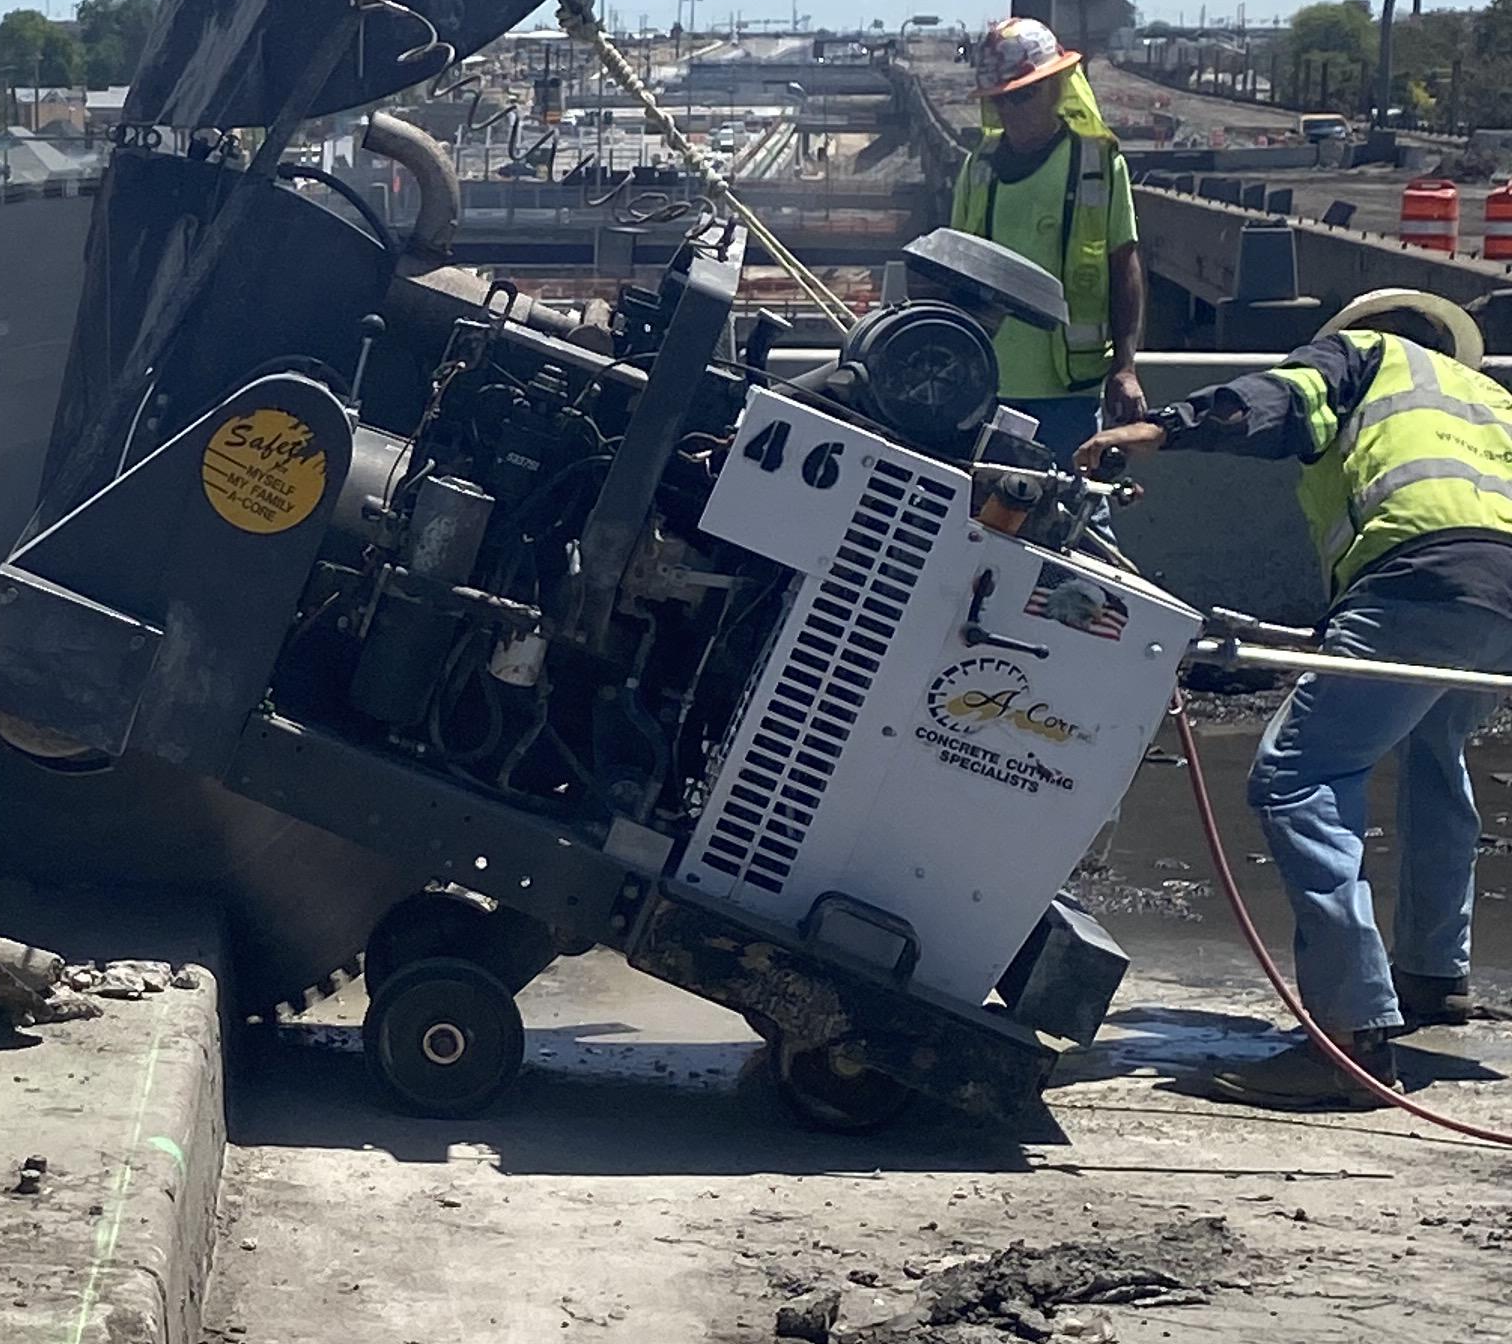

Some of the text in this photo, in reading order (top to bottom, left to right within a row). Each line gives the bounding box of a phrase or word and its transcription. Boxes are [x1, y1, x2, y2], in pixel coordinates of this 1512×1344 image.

[224, 424, 306, 464] Safet
[743, 420, 845, 489] 46
[226, 472, 296, 513] MY FAMILY
[246, 465, 296, 496] MYSELF
[228, 491, 276, 523] A-CORE
[915, 726, 1002, 765] CONCRETE
[939, 750, 1039, 793] SPECIALISTS
